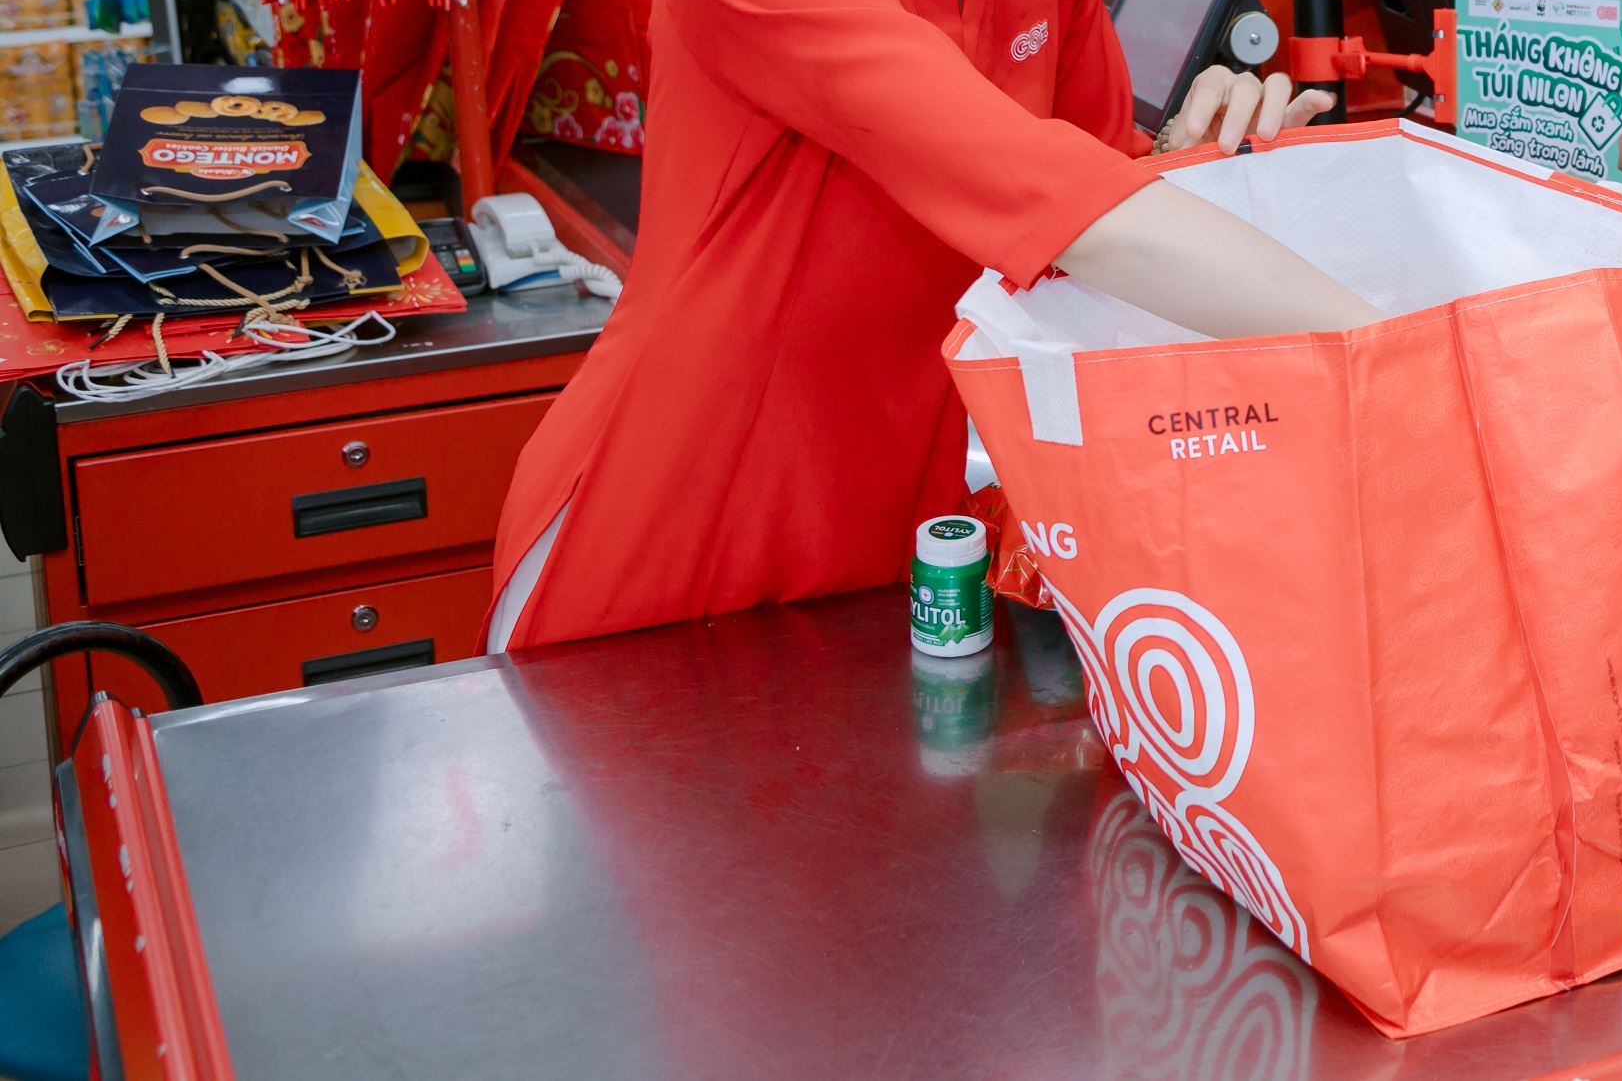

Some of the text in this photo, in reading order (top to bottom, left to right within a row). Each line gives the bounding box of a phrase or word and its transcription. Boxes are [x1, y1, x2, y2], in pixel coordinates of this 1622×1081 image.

[1457, 22, 1621, 91] THÁNG KHÔNG
[1475, 63, 1583, 113] TÚI NILON
[1465, 106, 1574, 142] Mua sắm xanh
[152, 149, 299, 165] MONTEGO
[1528, 138, 1570, 167] trong
[1572, 148, 1605, 177] lành
[1149, 403, 1279, 435] CENTRAL
[1170, 430, 1266, 460] RETAIL
[934, 525, 972, 535] XYLITOL
